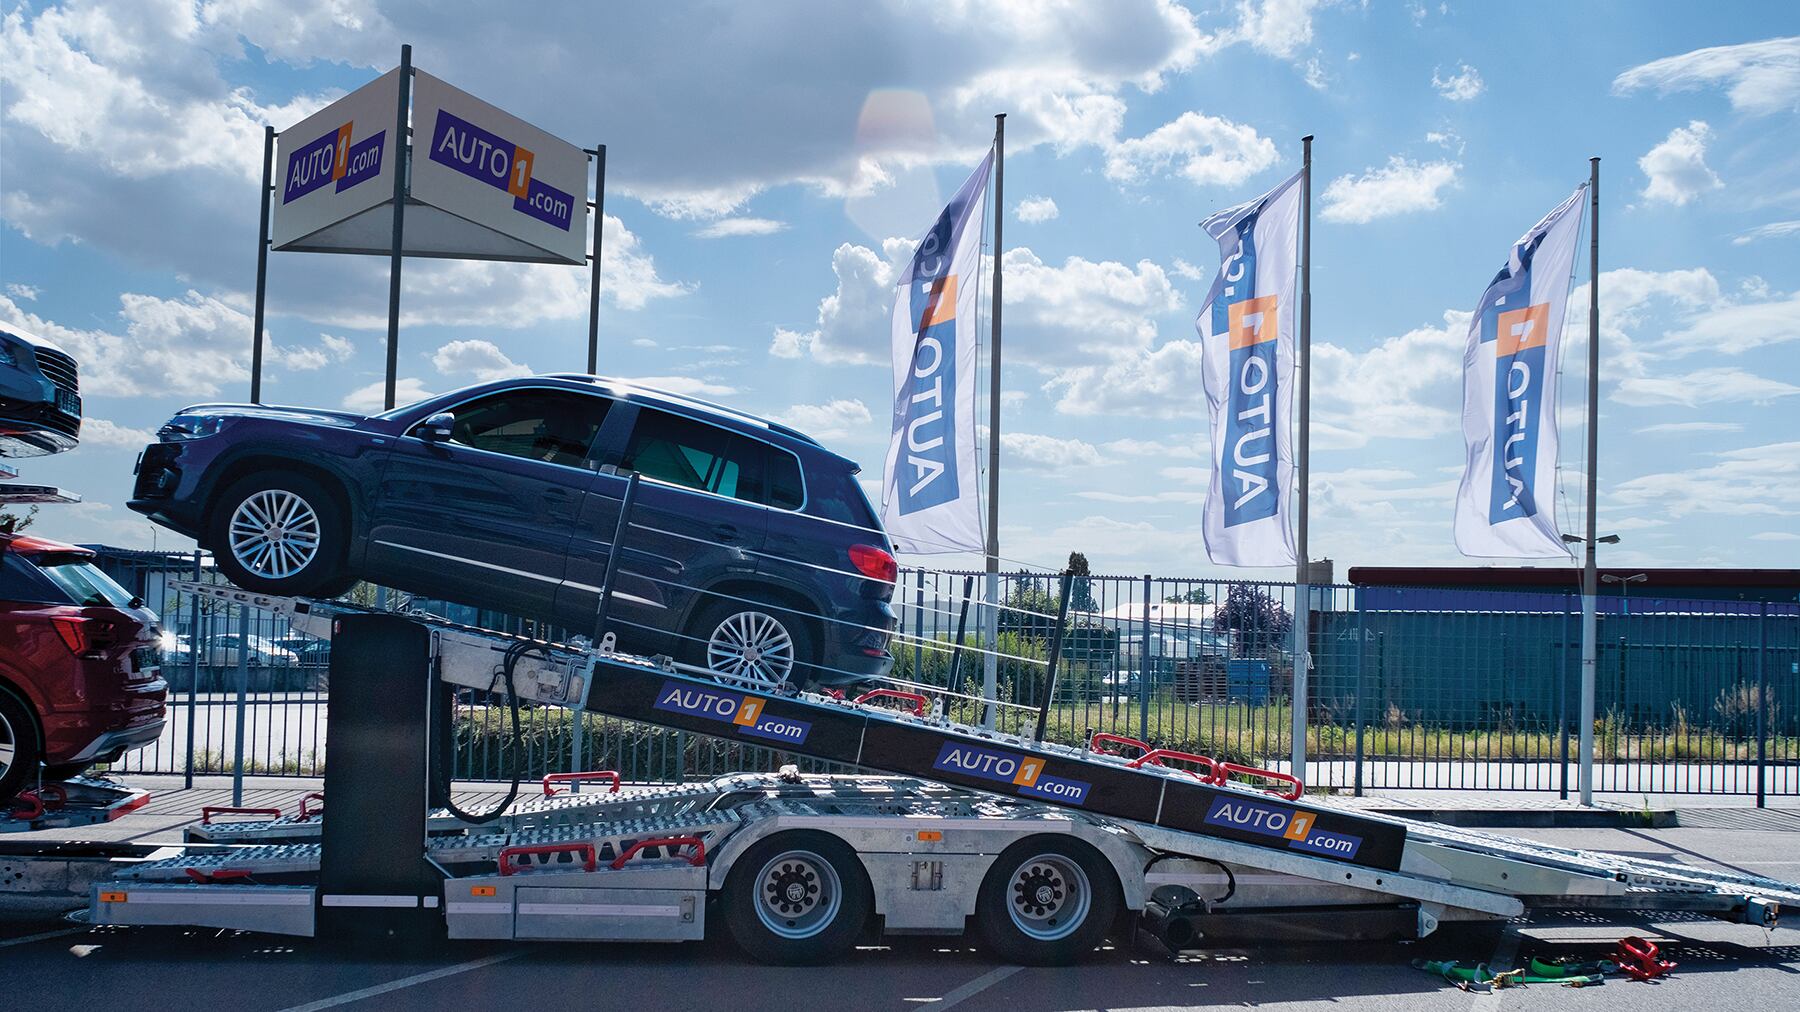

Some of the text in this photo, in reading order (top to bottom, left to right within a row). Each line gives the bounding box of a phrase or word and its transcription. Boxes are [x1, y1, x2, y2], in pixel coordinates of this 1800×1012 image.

[289, 135, 379, 192] AUTO1.com
[438, 126, 568, 220] AUTO1.com
[662, 688, 803, 738] AUTO1.com
[942, 748, 1082, 799] AUTO1.com
[1212, 803, 1353, 852] AUTO1.com
